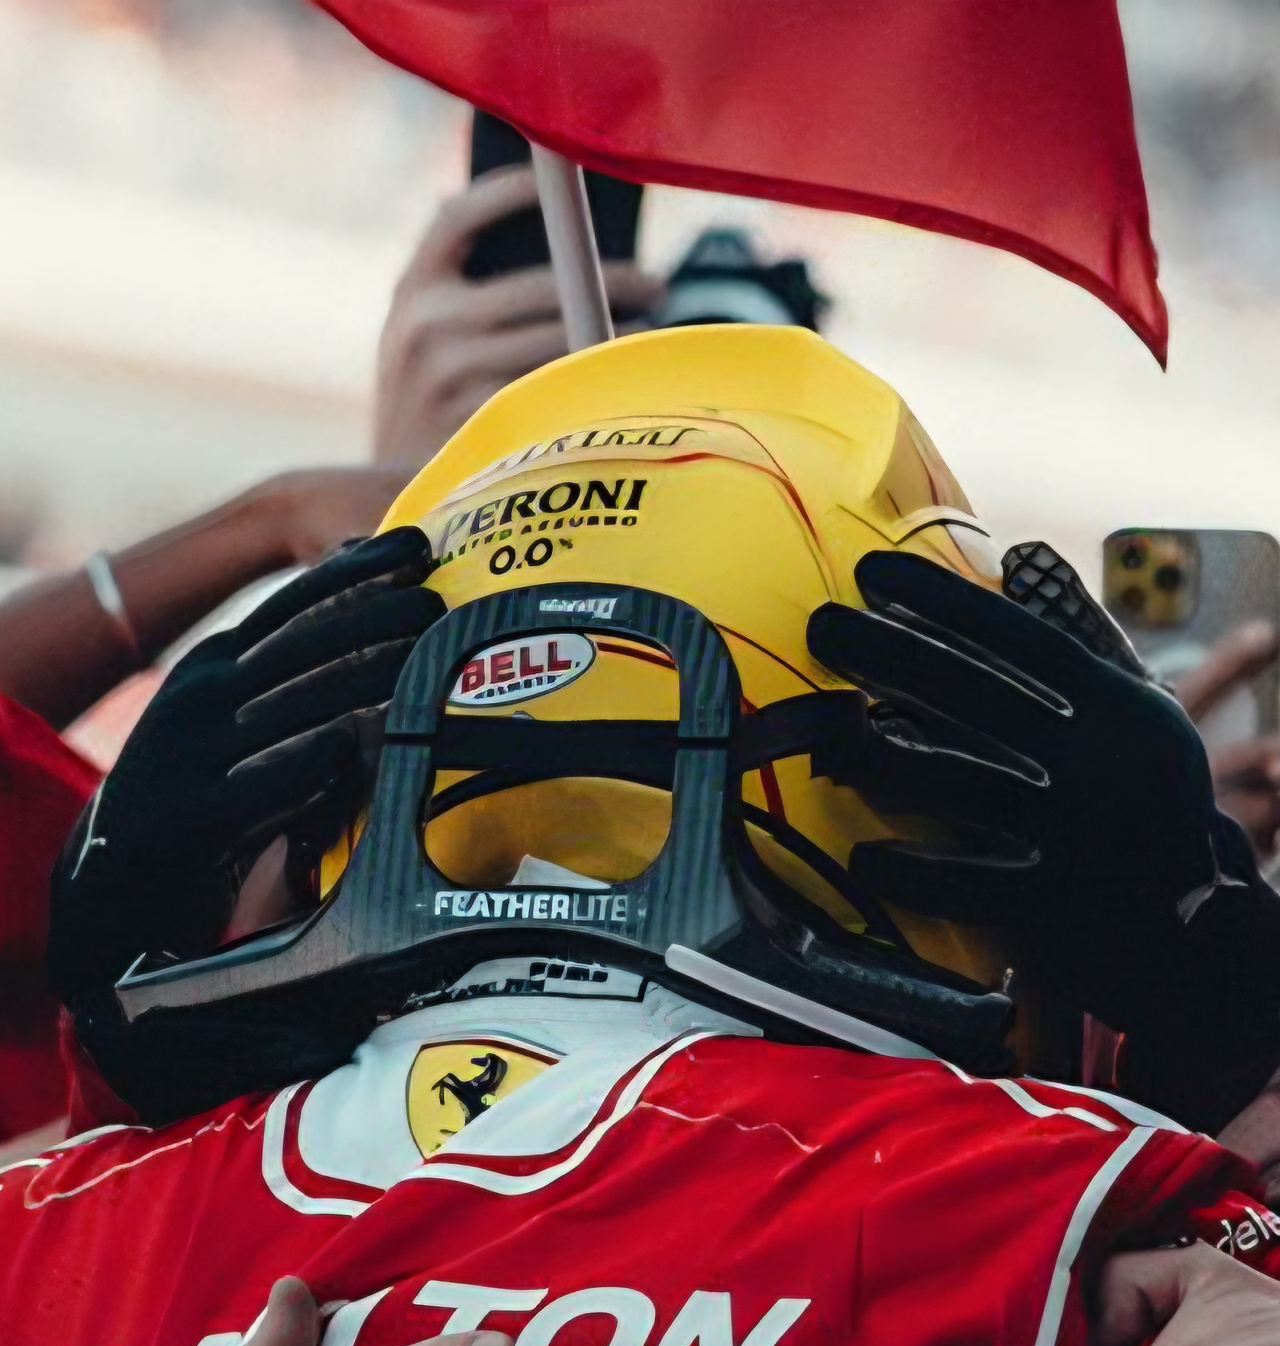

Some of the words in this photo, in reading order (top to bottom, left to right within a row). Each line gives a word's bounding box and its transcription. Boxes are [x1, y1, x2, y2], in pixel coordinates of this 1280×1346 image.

[437, 478, 648, 560] PERONI
[460, 641, 573, 694] BELL
[434, 890, 628, 922] FEATHERLITE
